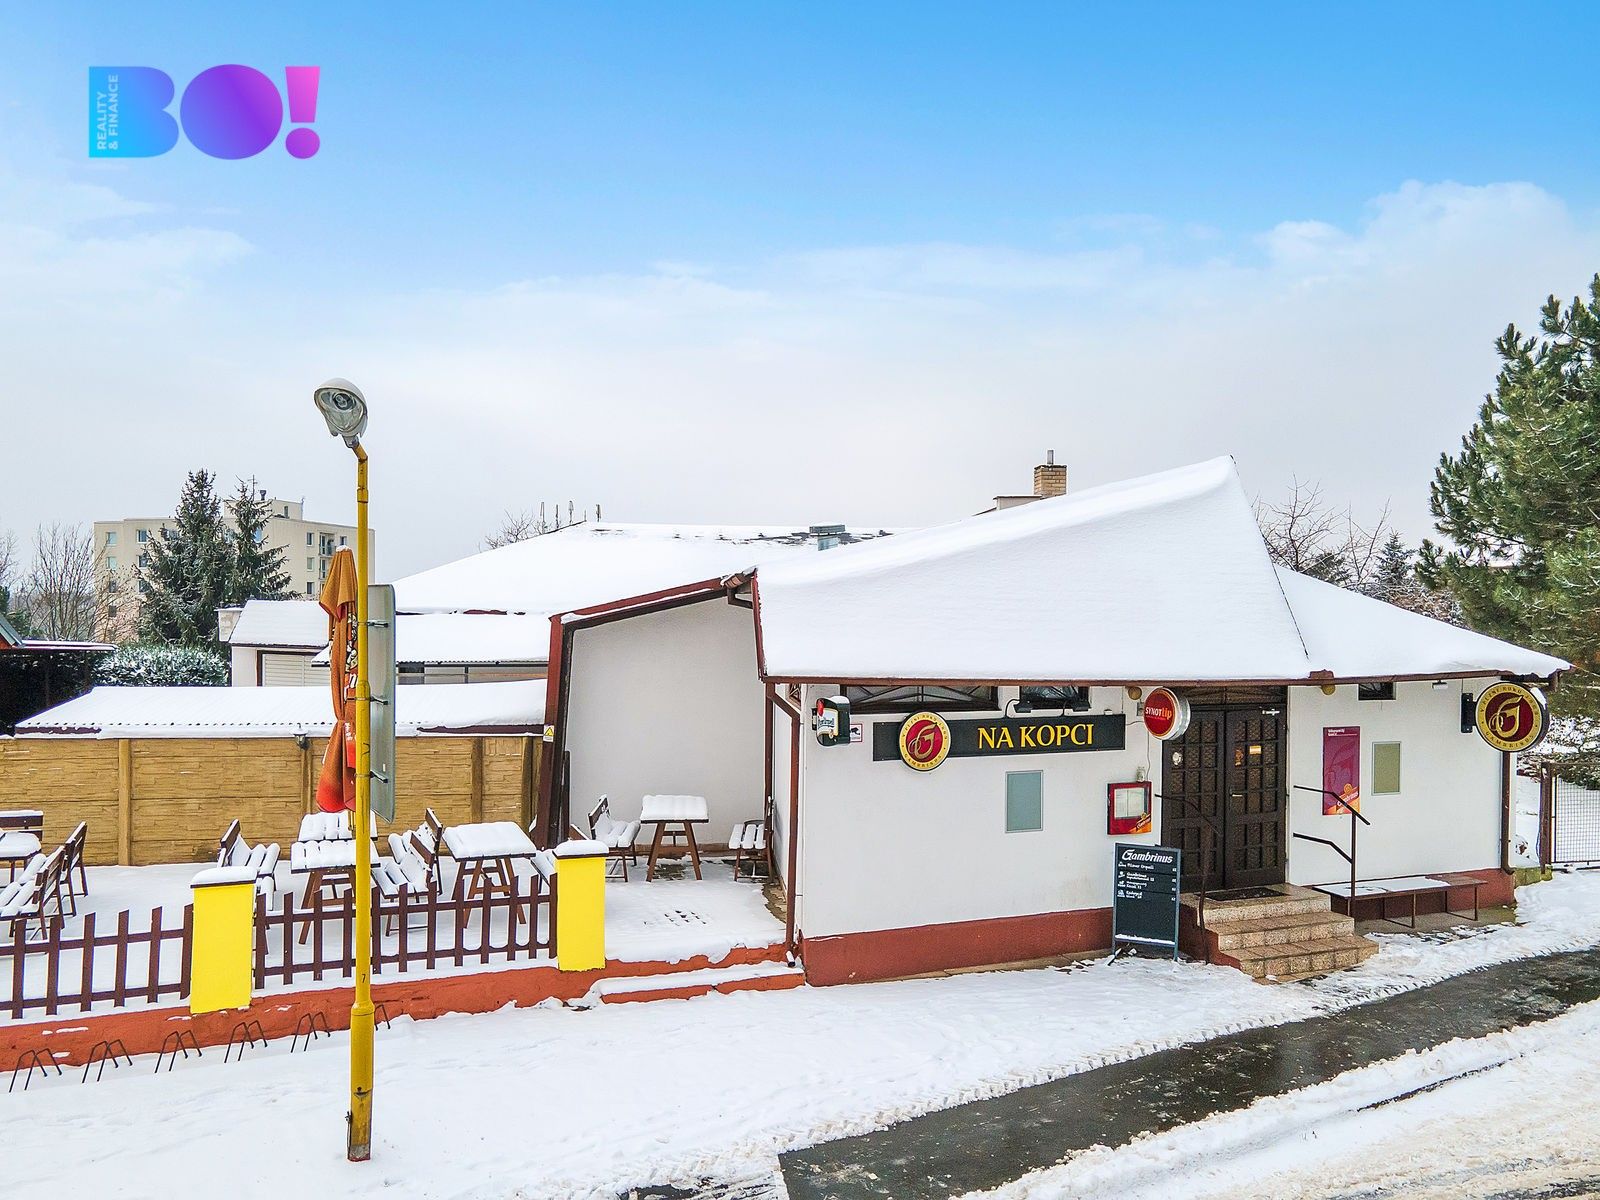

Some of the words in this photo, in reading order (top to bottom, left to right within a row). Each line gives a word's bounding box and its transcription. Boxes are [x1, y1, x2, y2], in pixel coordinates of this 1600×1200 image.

[977, 727, 1014, 749] NA
[1019, 723, 1095, 748] KOPCI
[1121, 849, 1173, 864] Gambrinus
